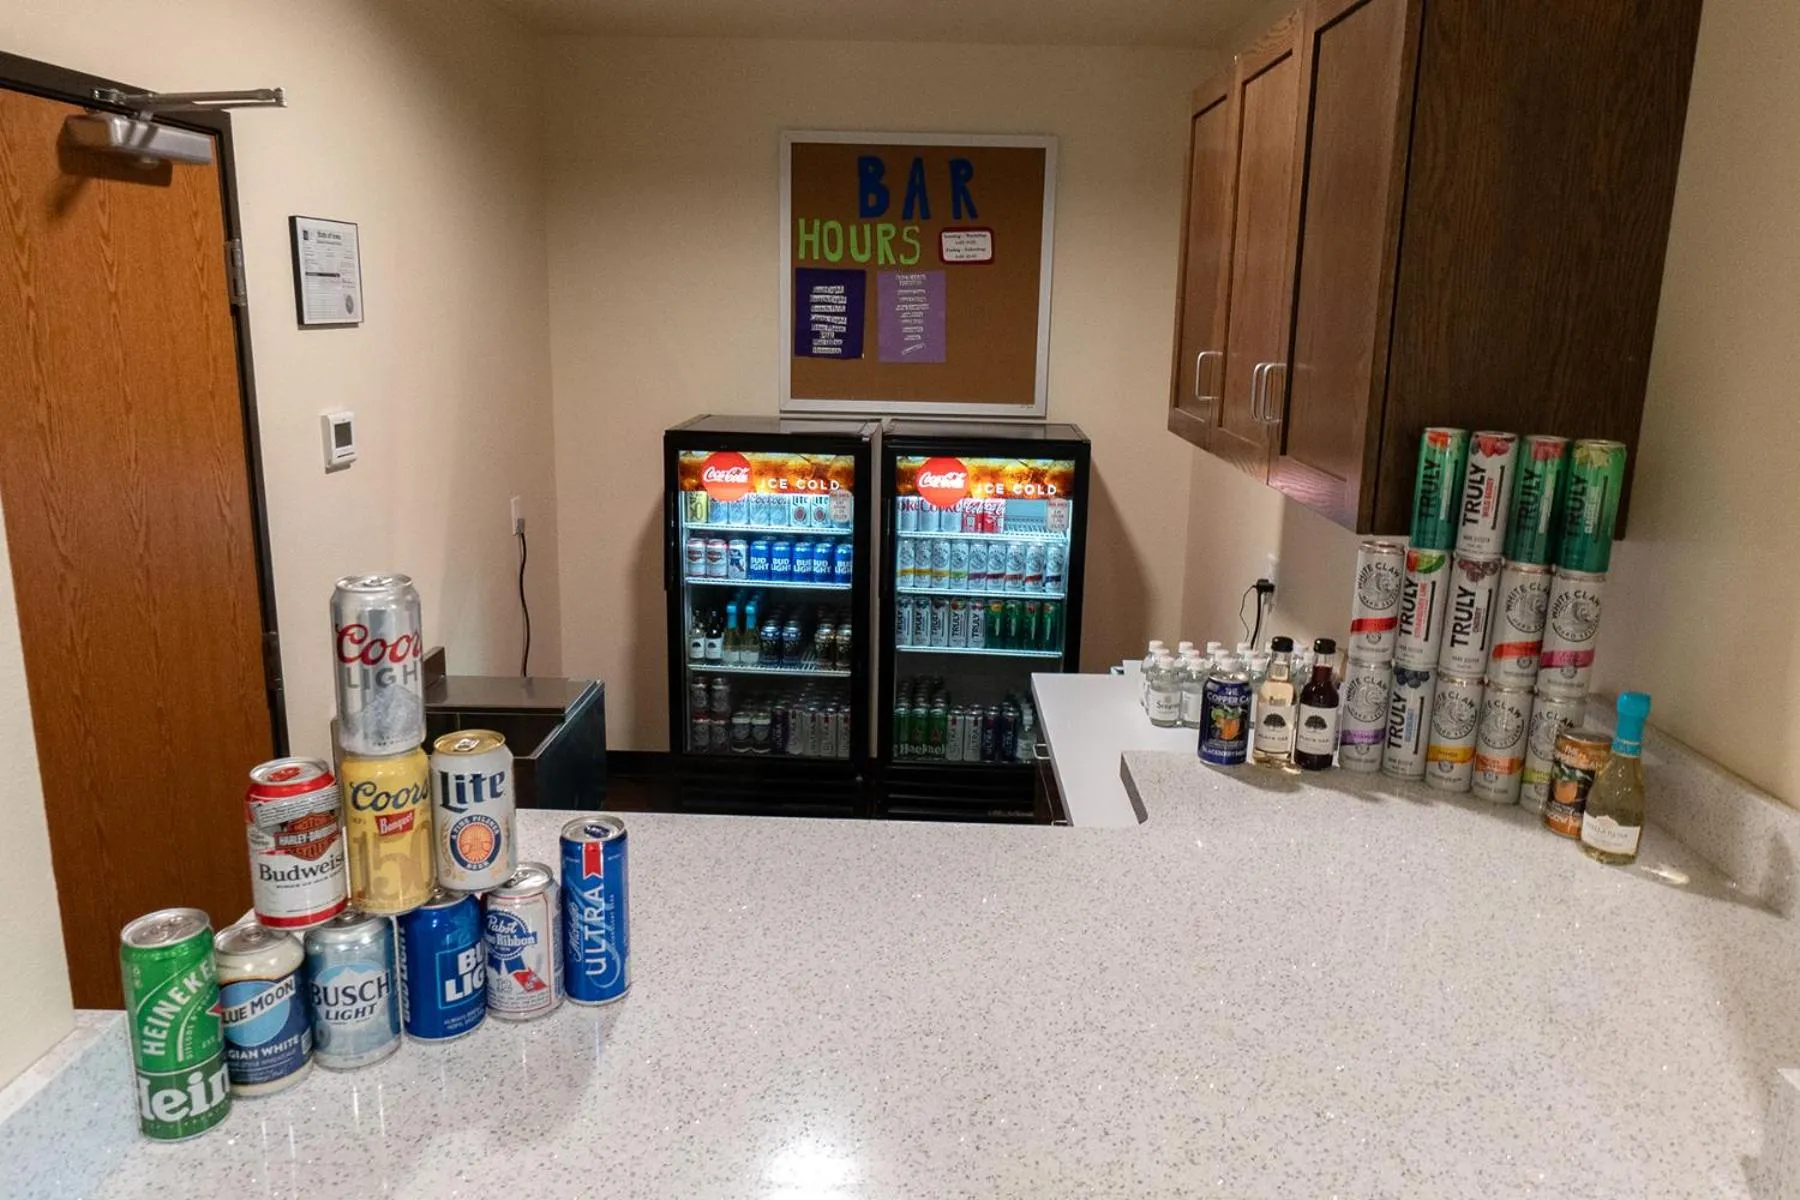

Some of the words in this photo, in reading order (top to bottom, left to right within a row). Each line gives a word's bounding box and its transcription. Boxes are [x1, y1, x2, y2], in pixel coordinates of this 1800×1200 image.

[857, 155, 979, 221] BAR
[798, 217, 921, 265] HOURS
[703, 466, 750, 483] Coca-Cola
[759, 477, 788, 490] ICE
[795, 479, 840, 490] COLD
[918, 471, 967, 489] Coca-Cola
[976, 482, 1004, 495] ICE
[1012, 483, 1057, 496] COLD
[1420, 457, 1441, 519] TRULY
[1462, 462, 1487, 526] TRULY
[1518, 467, 1542, 534] TRULY
[1566, 472, 1588, 537] TRULY
[1399, 576, 1419, 637] TRULY
[1529, 582, 1550, 595] CLA
[972, 613, 980, 638] TRULY
[1450, 585, 1476, 648] TRULY
[335, 624, 422, 666] Coor
[346, 661, 418, 690] LIGH
[1387, 692, 1407, 749] TRULY
[350, 779, 429, 812] Coors
[439, 770, 505, 814] Lite
[258, 853, 344, 882] Budweis
[487, 914, 518, 934] Pabst
[497, 933, 536, 947] Ribbon
[584, 882, 607, 976] ULTRA
[221, 1005, 249, 1024] LUE
[250, 978, 295, 1016] MOON
[311, 971, 390, 1007] BUSCH
[445, 961, 486, 1003] LIG
[143, 958, 216, 1056] HEINEKE
[325, 1002, 377, 1021] LIGHT
[228, 1049, 259, 1061] GIAN
[262, 1034, 300, 1057] WHITE
